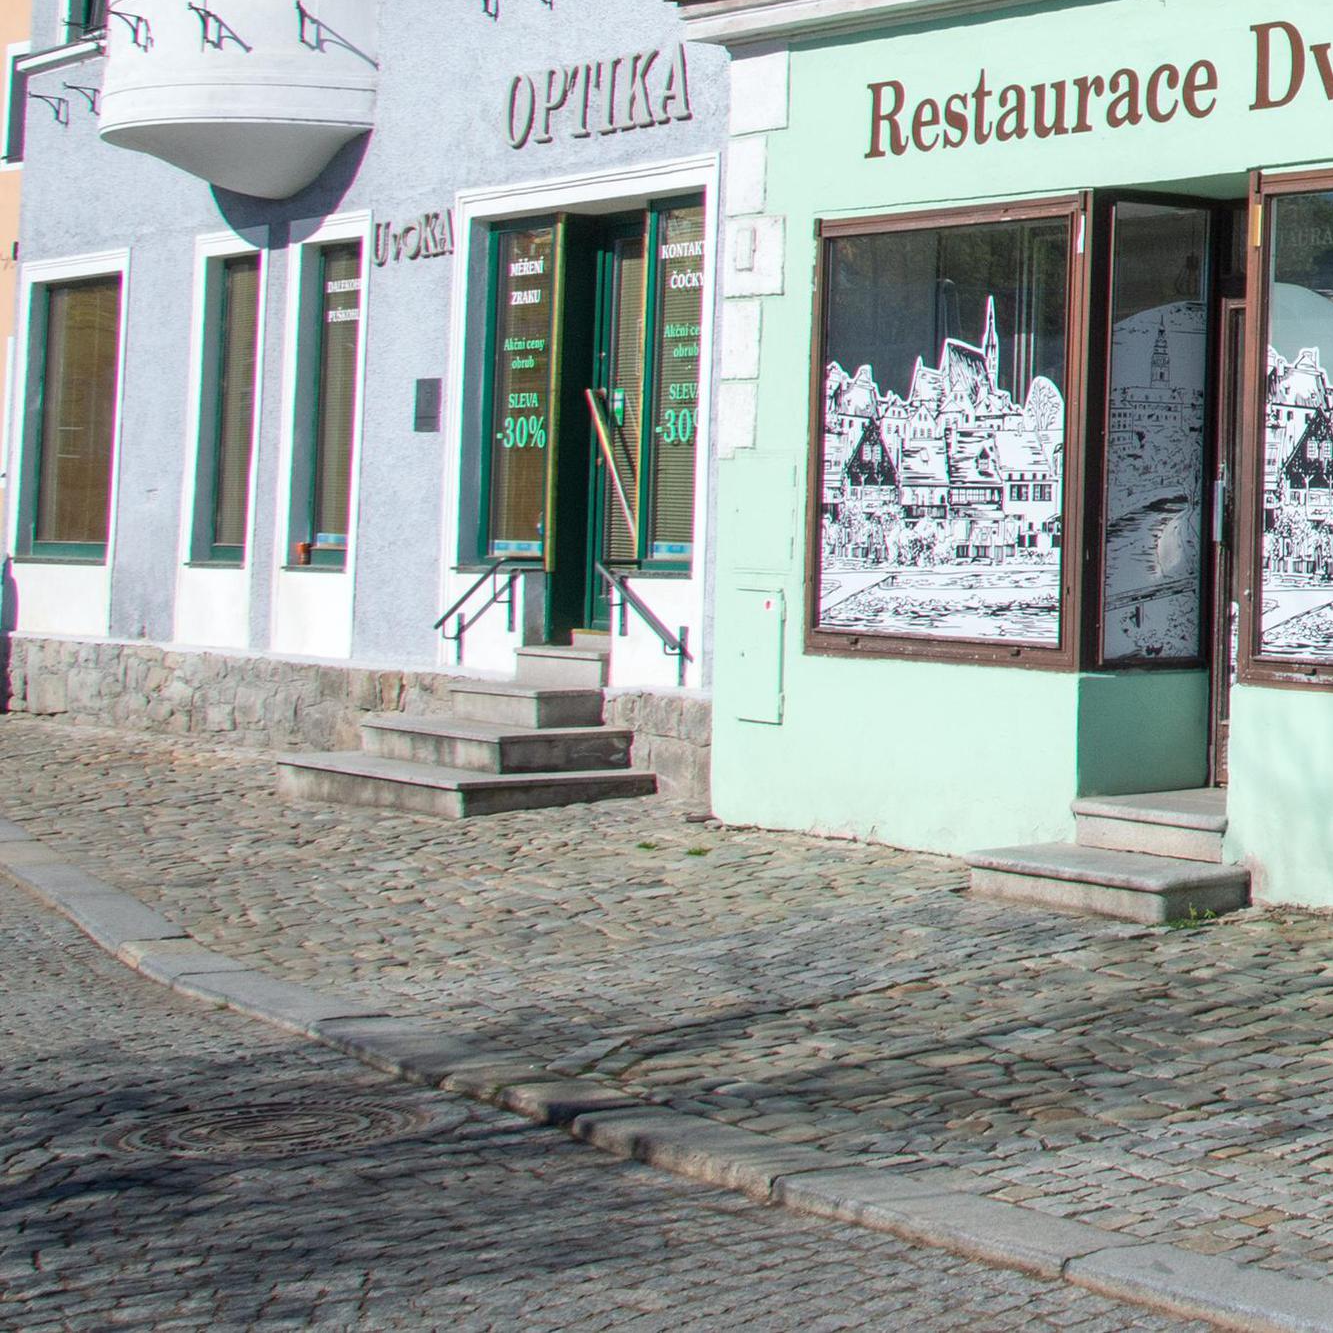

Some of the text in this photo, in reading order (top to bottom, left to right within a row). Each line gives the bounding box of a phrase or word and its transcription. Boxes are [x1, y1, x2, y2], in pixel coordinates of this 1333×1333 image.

[504, 41, 692, 149] OPTIKA
[864, 59, 1218, 159] Restaurace
[511, 289, 541, 305] ZRAKU
[509, 392, 538, 409] SLEVA
[496, 416, 546, 449] -30%
